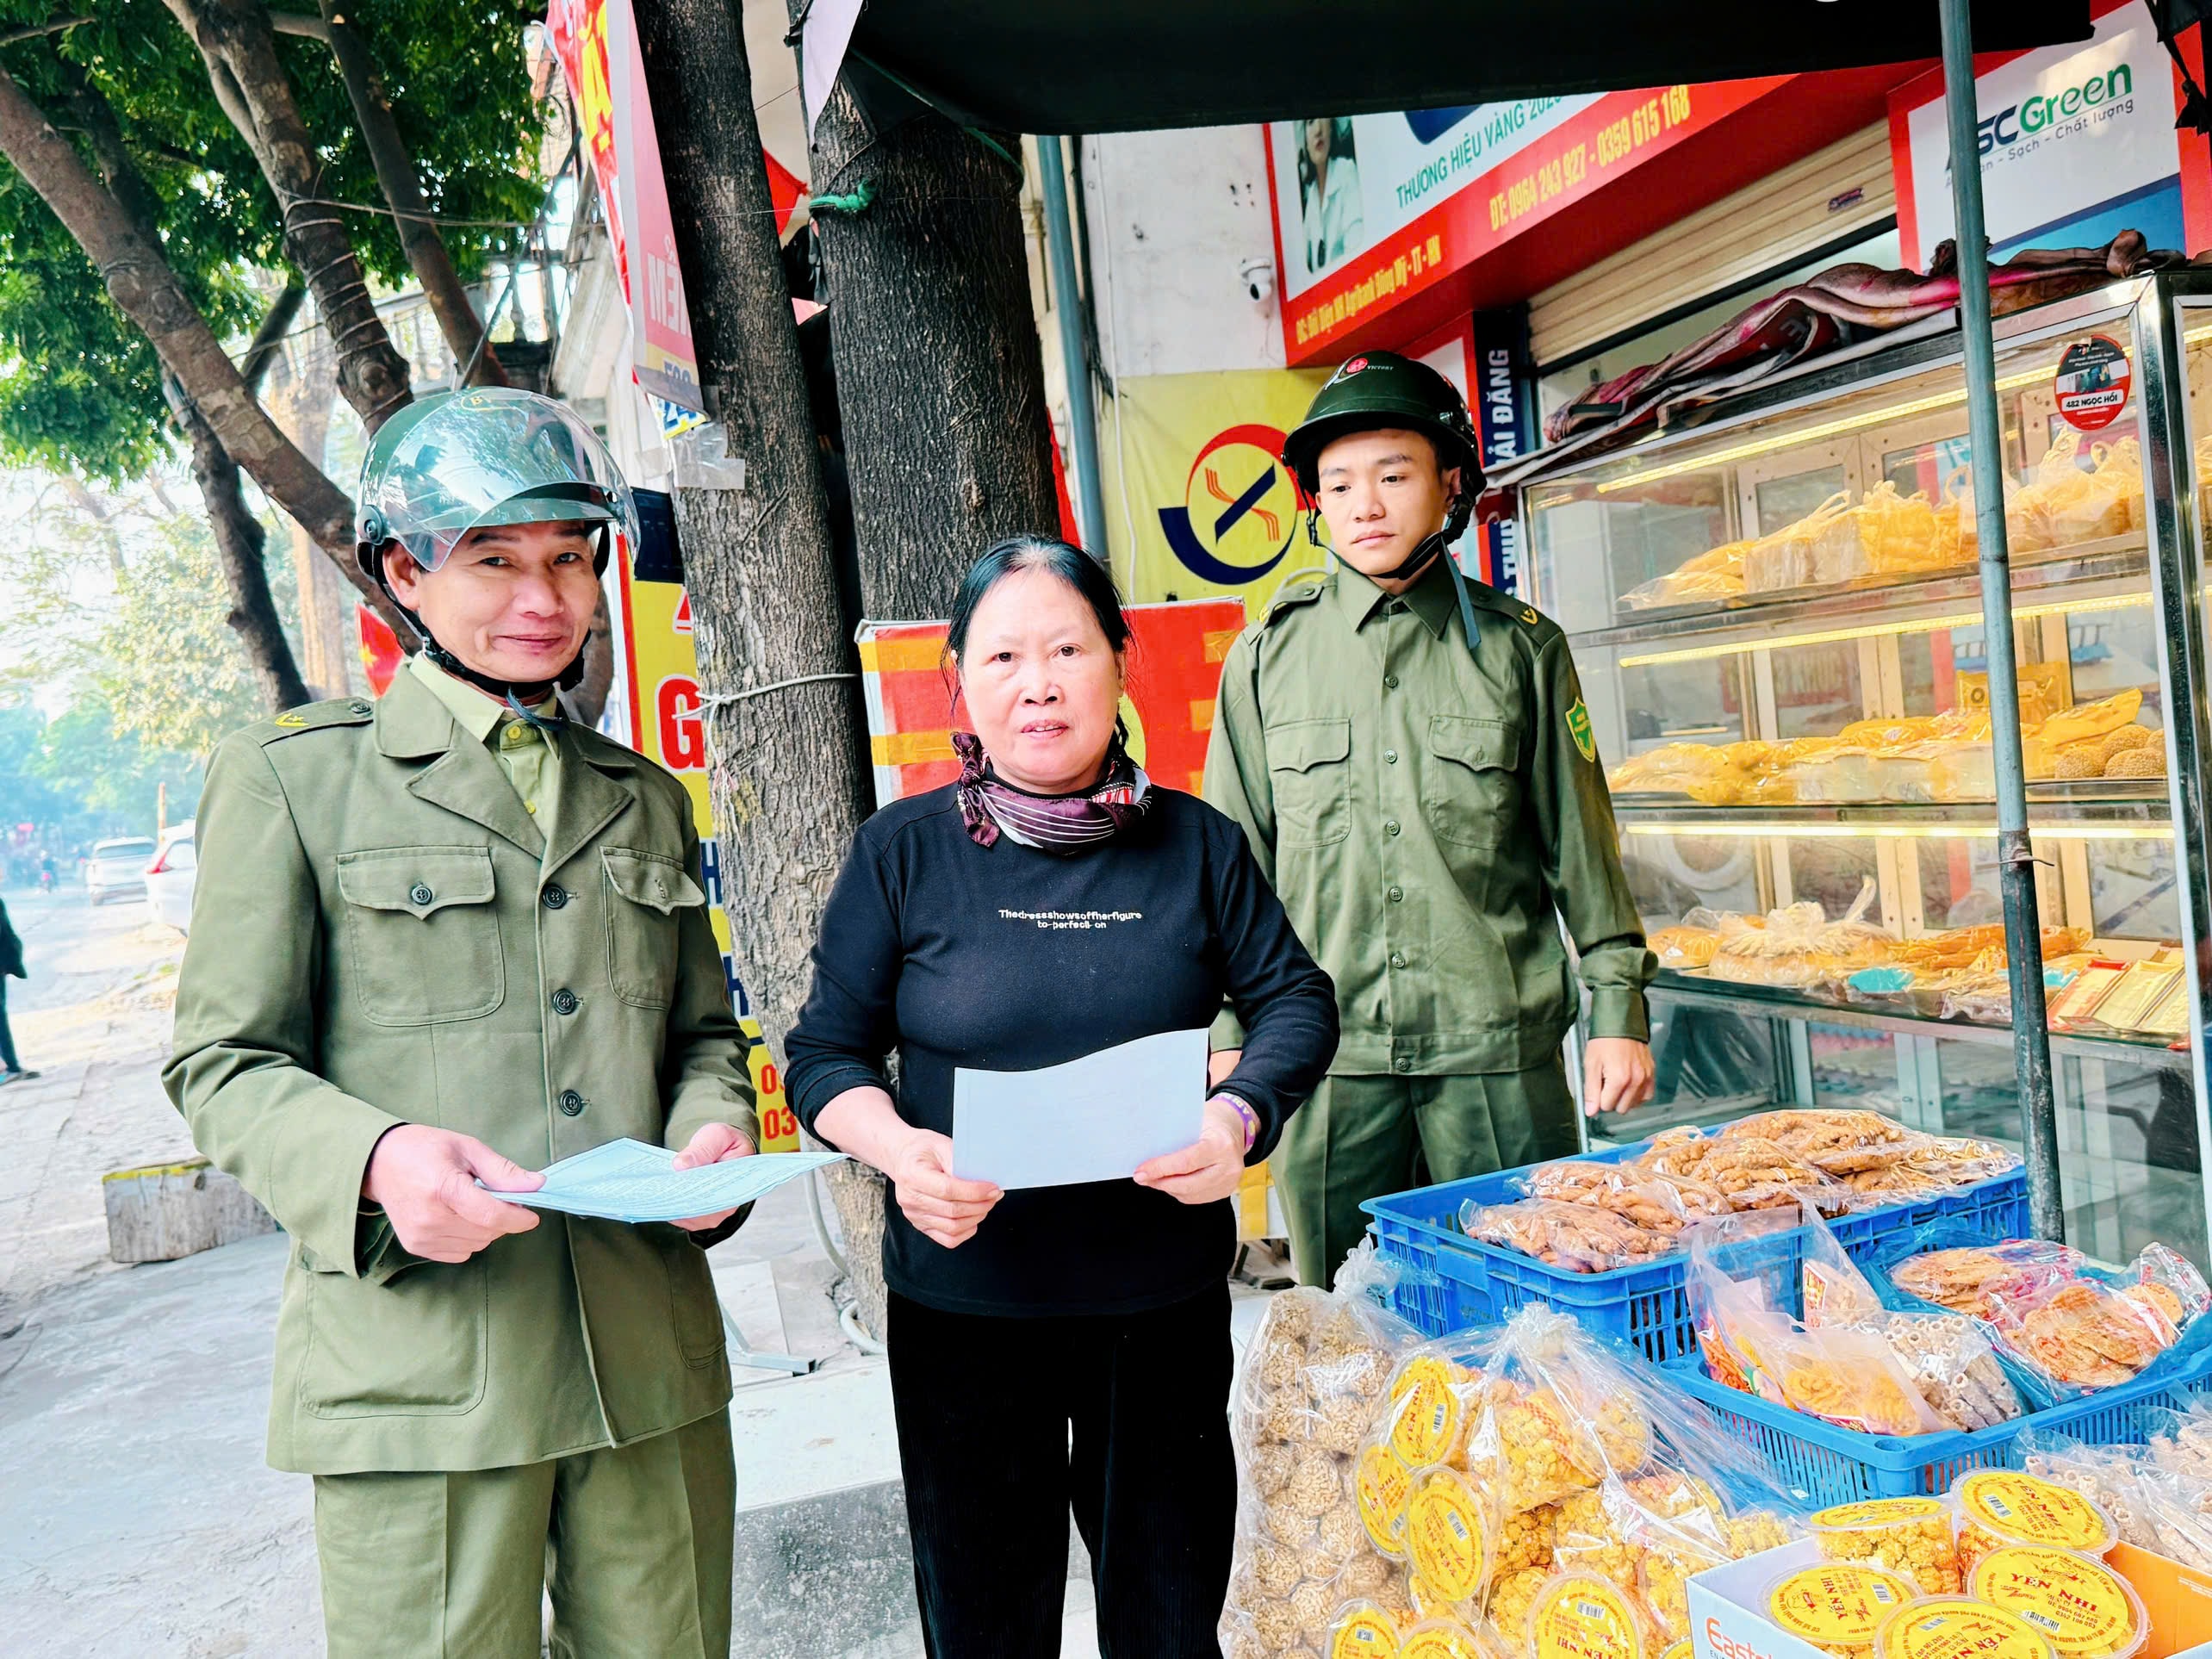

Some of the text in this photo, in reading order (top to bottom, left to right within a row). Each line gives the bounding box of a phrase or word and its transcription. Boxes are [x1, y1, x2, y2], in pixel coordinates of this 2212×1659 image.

[1485, 103, 1525, 148] VÀNG
[1563, 142, 1587, 188] 927
[1597, 116, 1631, 168] 0359
[1632, 98, 1661, 146] 615
[1661, 84, 1691, 129] 168
[2008, 139, 2040, 161] Sạch
[2055, 119, 2088, 140] Chất
[2093, 99, 2134, 123] lượng
[1487, 349, 1515, 425] ĐĂNG
[2059, 1589, 2098, 1612] NHI
